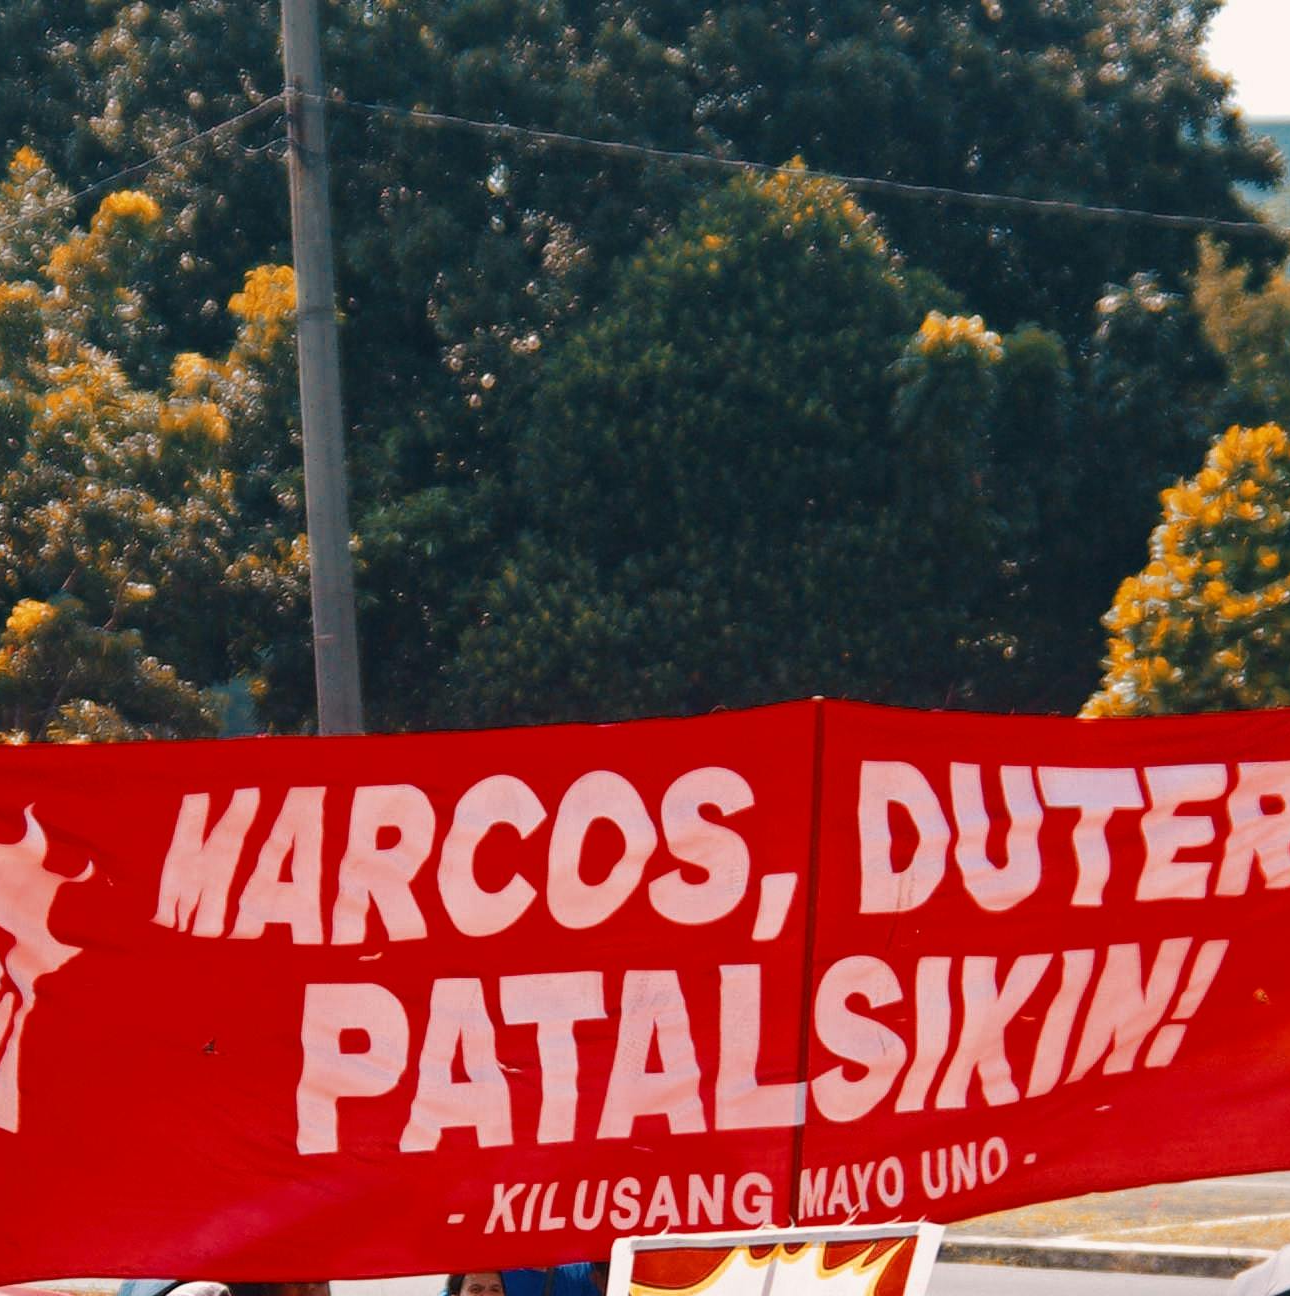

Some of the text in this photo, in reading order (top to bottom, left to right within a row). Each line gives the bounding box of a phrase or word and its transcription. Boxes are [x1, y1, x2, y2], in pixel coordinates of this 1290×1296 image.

[150, 765, 798, 945] MARCOS,
[296, 938, 1229, 1155] PATALSIKIN!
[484, 1172, 774, 1234] KILUSANG
[798, 1156, 905, 1220] MAYO
[922, 1136, 1009, 1200] UNO
